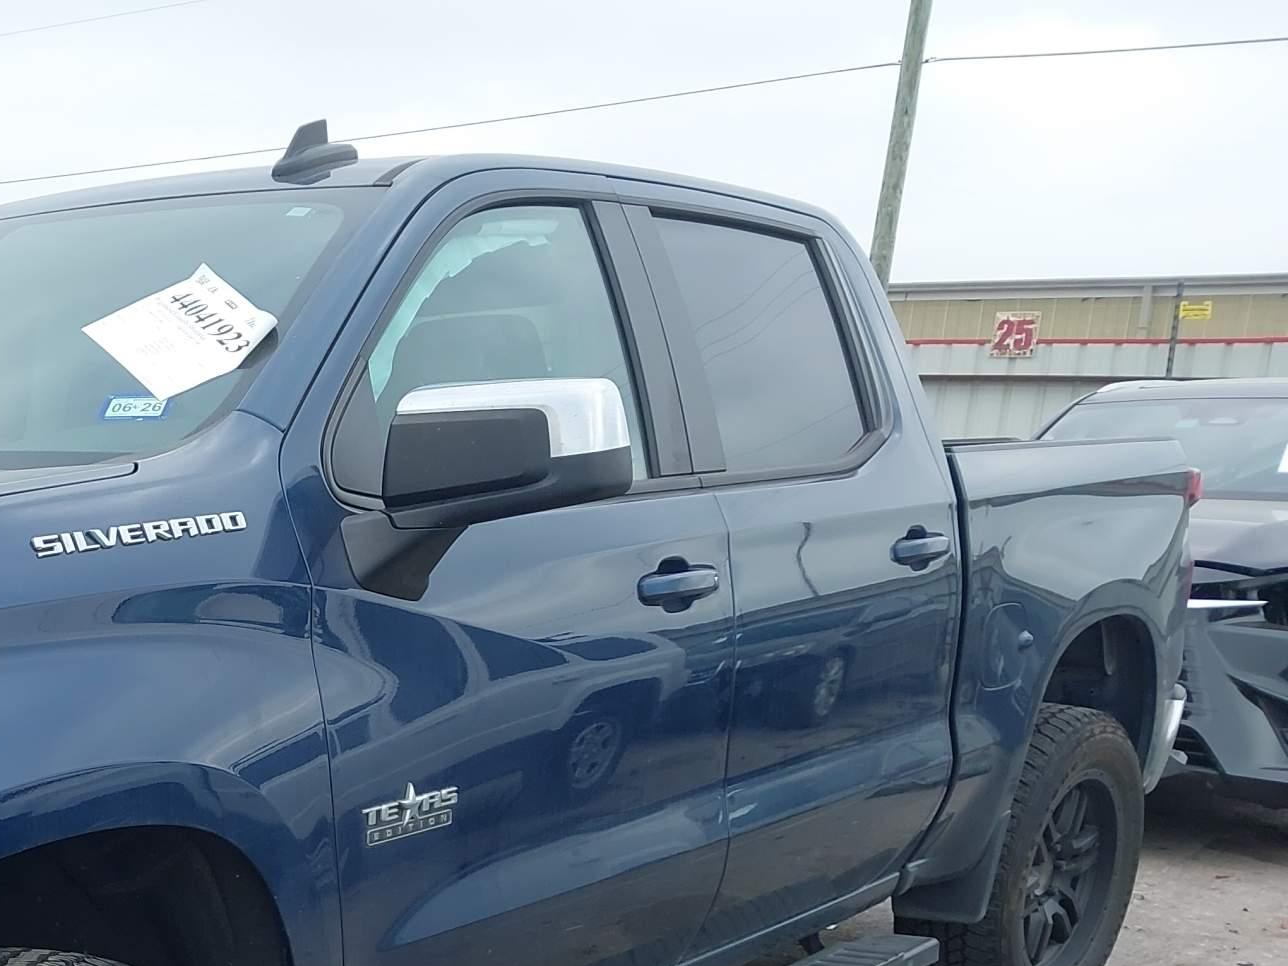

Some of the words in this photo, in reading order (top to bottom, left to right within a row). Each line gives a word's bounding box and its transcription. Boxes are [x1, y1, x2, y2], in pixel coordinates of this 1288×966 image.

[170, 293, 251, 353] 44041923
[992, 319, 1035, 350] 25
[111, 403, 133, 413] 06
[140, 402, 163, 412] 26
[31, 511, 247, 558] SILVERADO
[362, 783, 458, 827] TEXAS
[372, 813, 448, 841] EDITION
